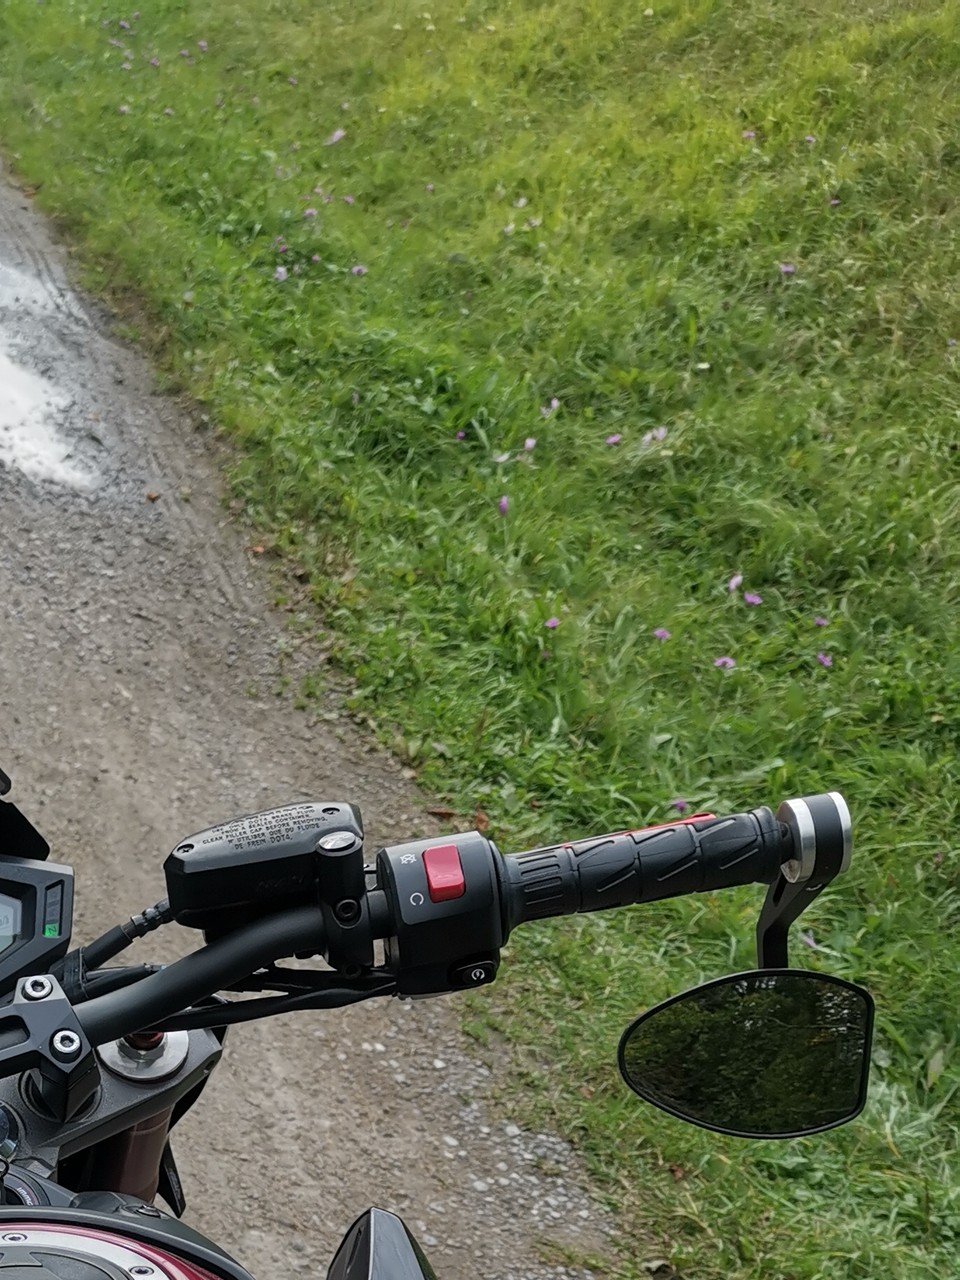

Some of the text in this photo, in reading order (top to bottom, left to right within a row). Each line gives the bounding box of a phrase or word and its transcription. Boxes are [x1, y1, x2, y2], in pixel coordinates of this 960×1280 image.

[248, 820, 273, 830] SEALED
[269, 828, 282, 836] QUE
[284, 826, 295, 834] DU
[296, 821, 320, 832] FLUIDE
[202, 835, 223, 845] CLEAN
[226, 829, 248, 840] FILLER
[250, 826, 263, 835] CAP
[265, 821, 290, 832] BEFORE
[234, 842, 244, 851] DE
[246, 838, 267, 848] FREIN
